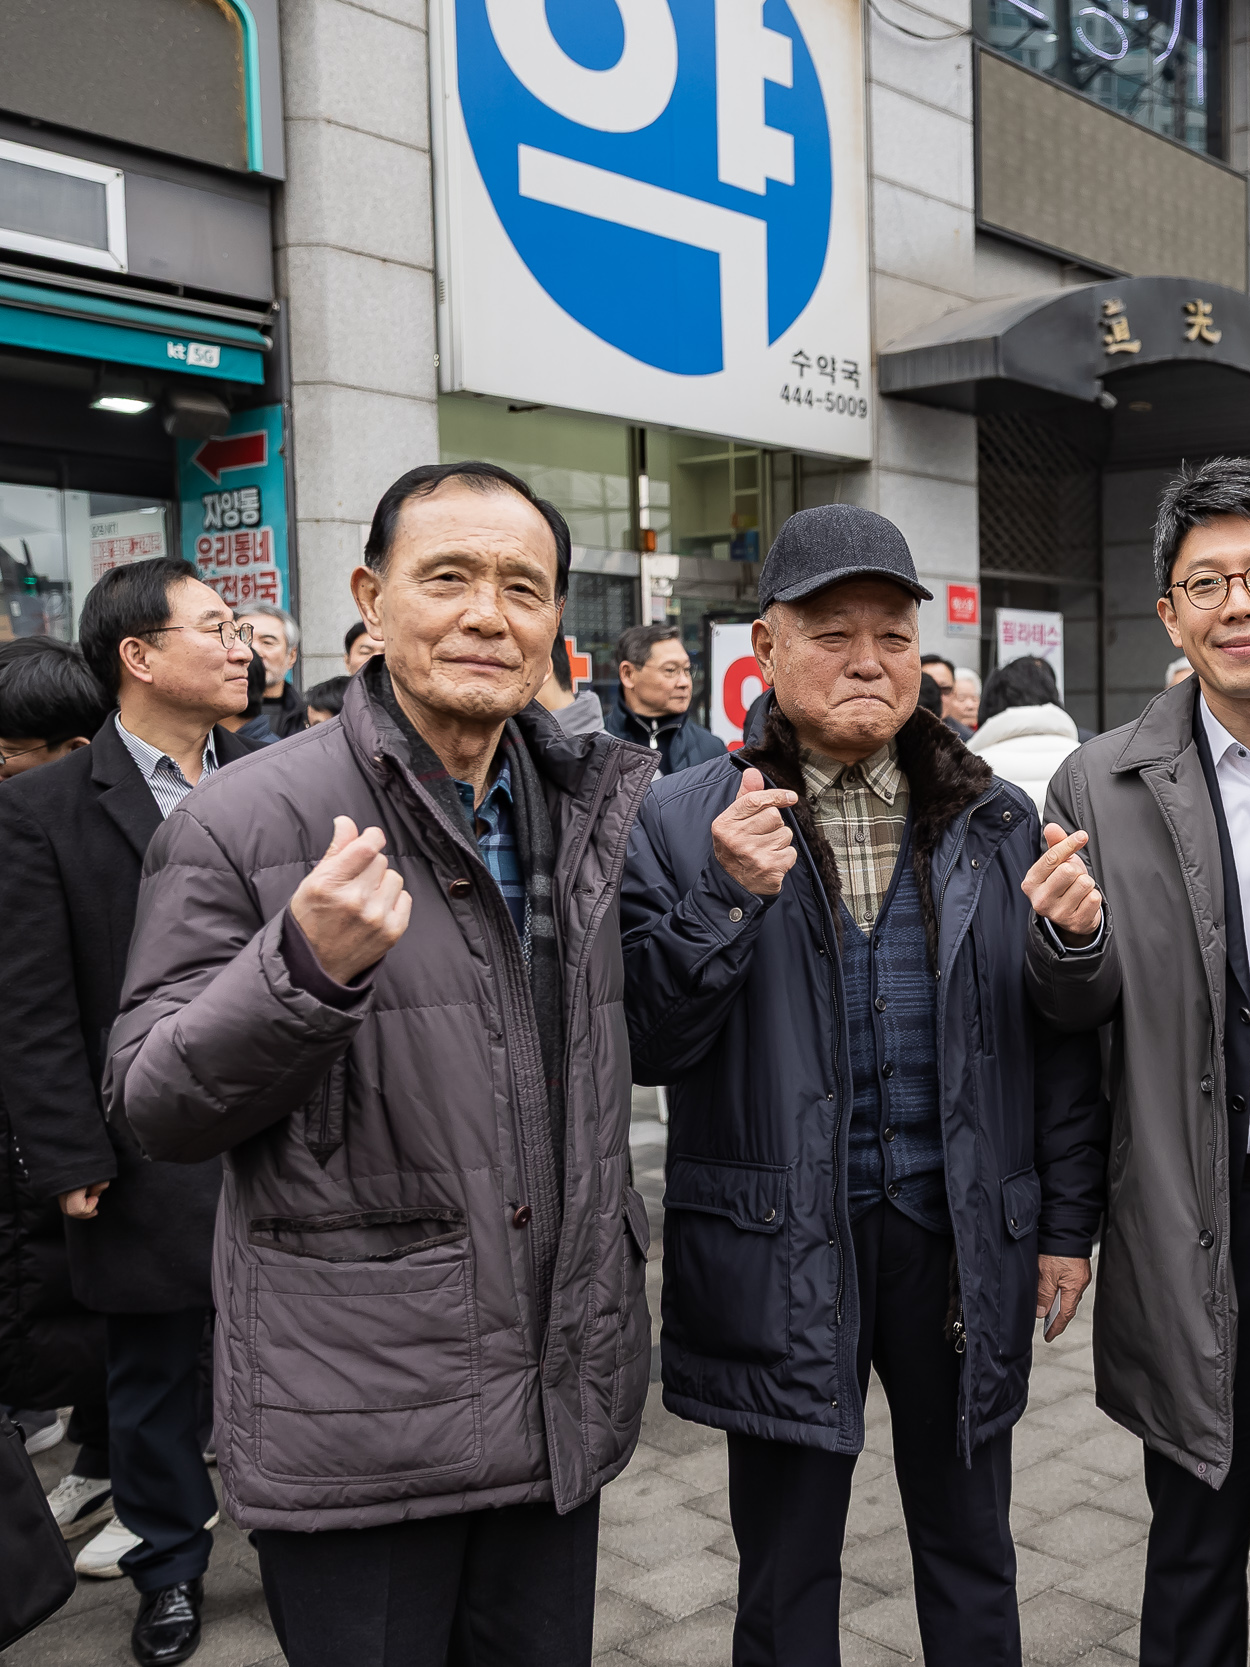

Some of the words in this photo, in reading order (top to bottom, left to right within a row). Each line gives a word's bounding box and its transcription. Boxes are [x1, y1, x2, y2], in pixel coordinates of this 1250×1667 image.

[791, 350, 860, 389] 수약국
[780, 384, 868, 419] 444-5009
[203, 486, 261, 531] 자양동
[197, 530, 271, 570] 우리동네
[1002, 621, 1062, 647] 필라테스
